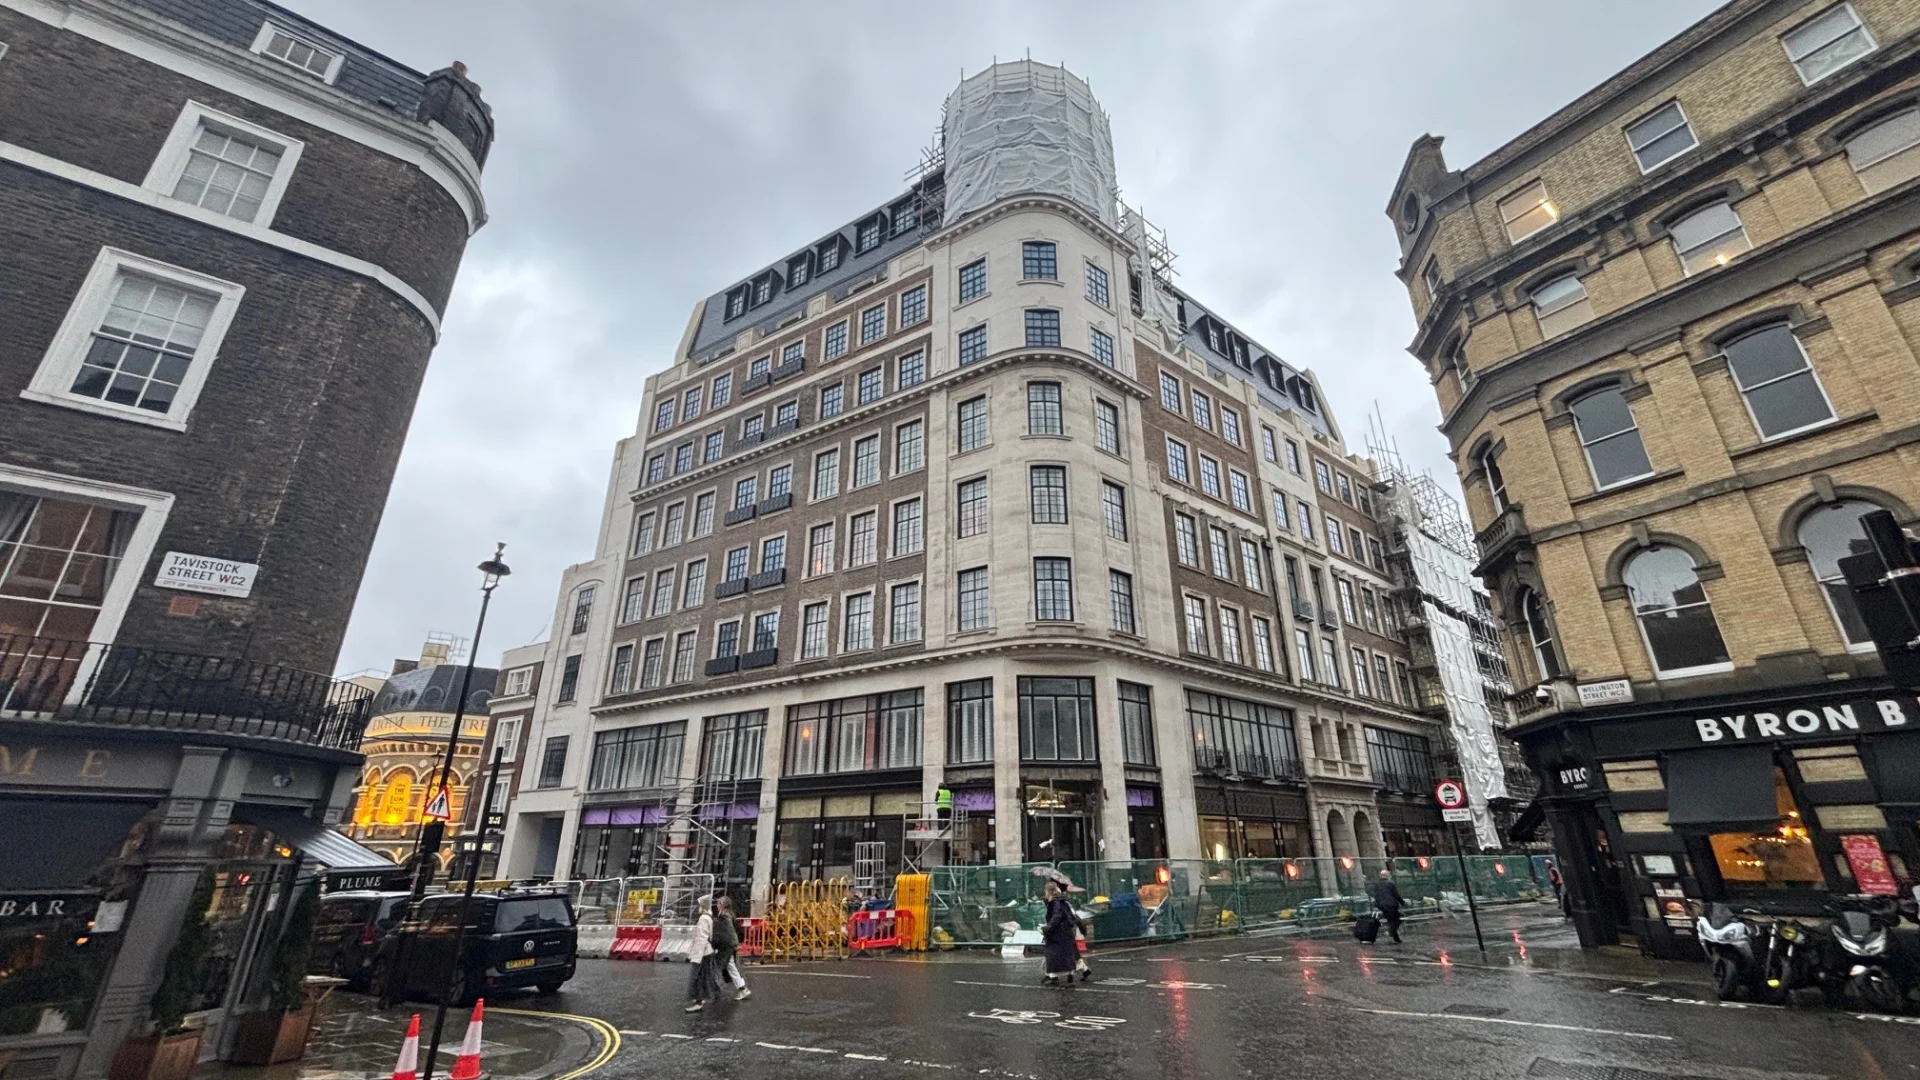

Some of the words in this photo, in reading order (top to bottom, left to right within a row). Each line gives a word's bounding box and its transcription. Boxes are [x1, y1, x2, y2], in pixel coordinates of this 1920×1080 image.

[173, 556, 240, 574] TAVISTOCK
[168, 567, 214, 581] STREET
[219, 574, 246, 586] WC2
[1582, 683, 1625, 693] WELLINGTON
[419, 715, 489, 731] THETRE
[1696, 704, 1859, 742] BYRON
[1876, 697, 1920, 726] B
[340, 876, 382, 889] PLUME
[0, 900, 65, 916] BAR
